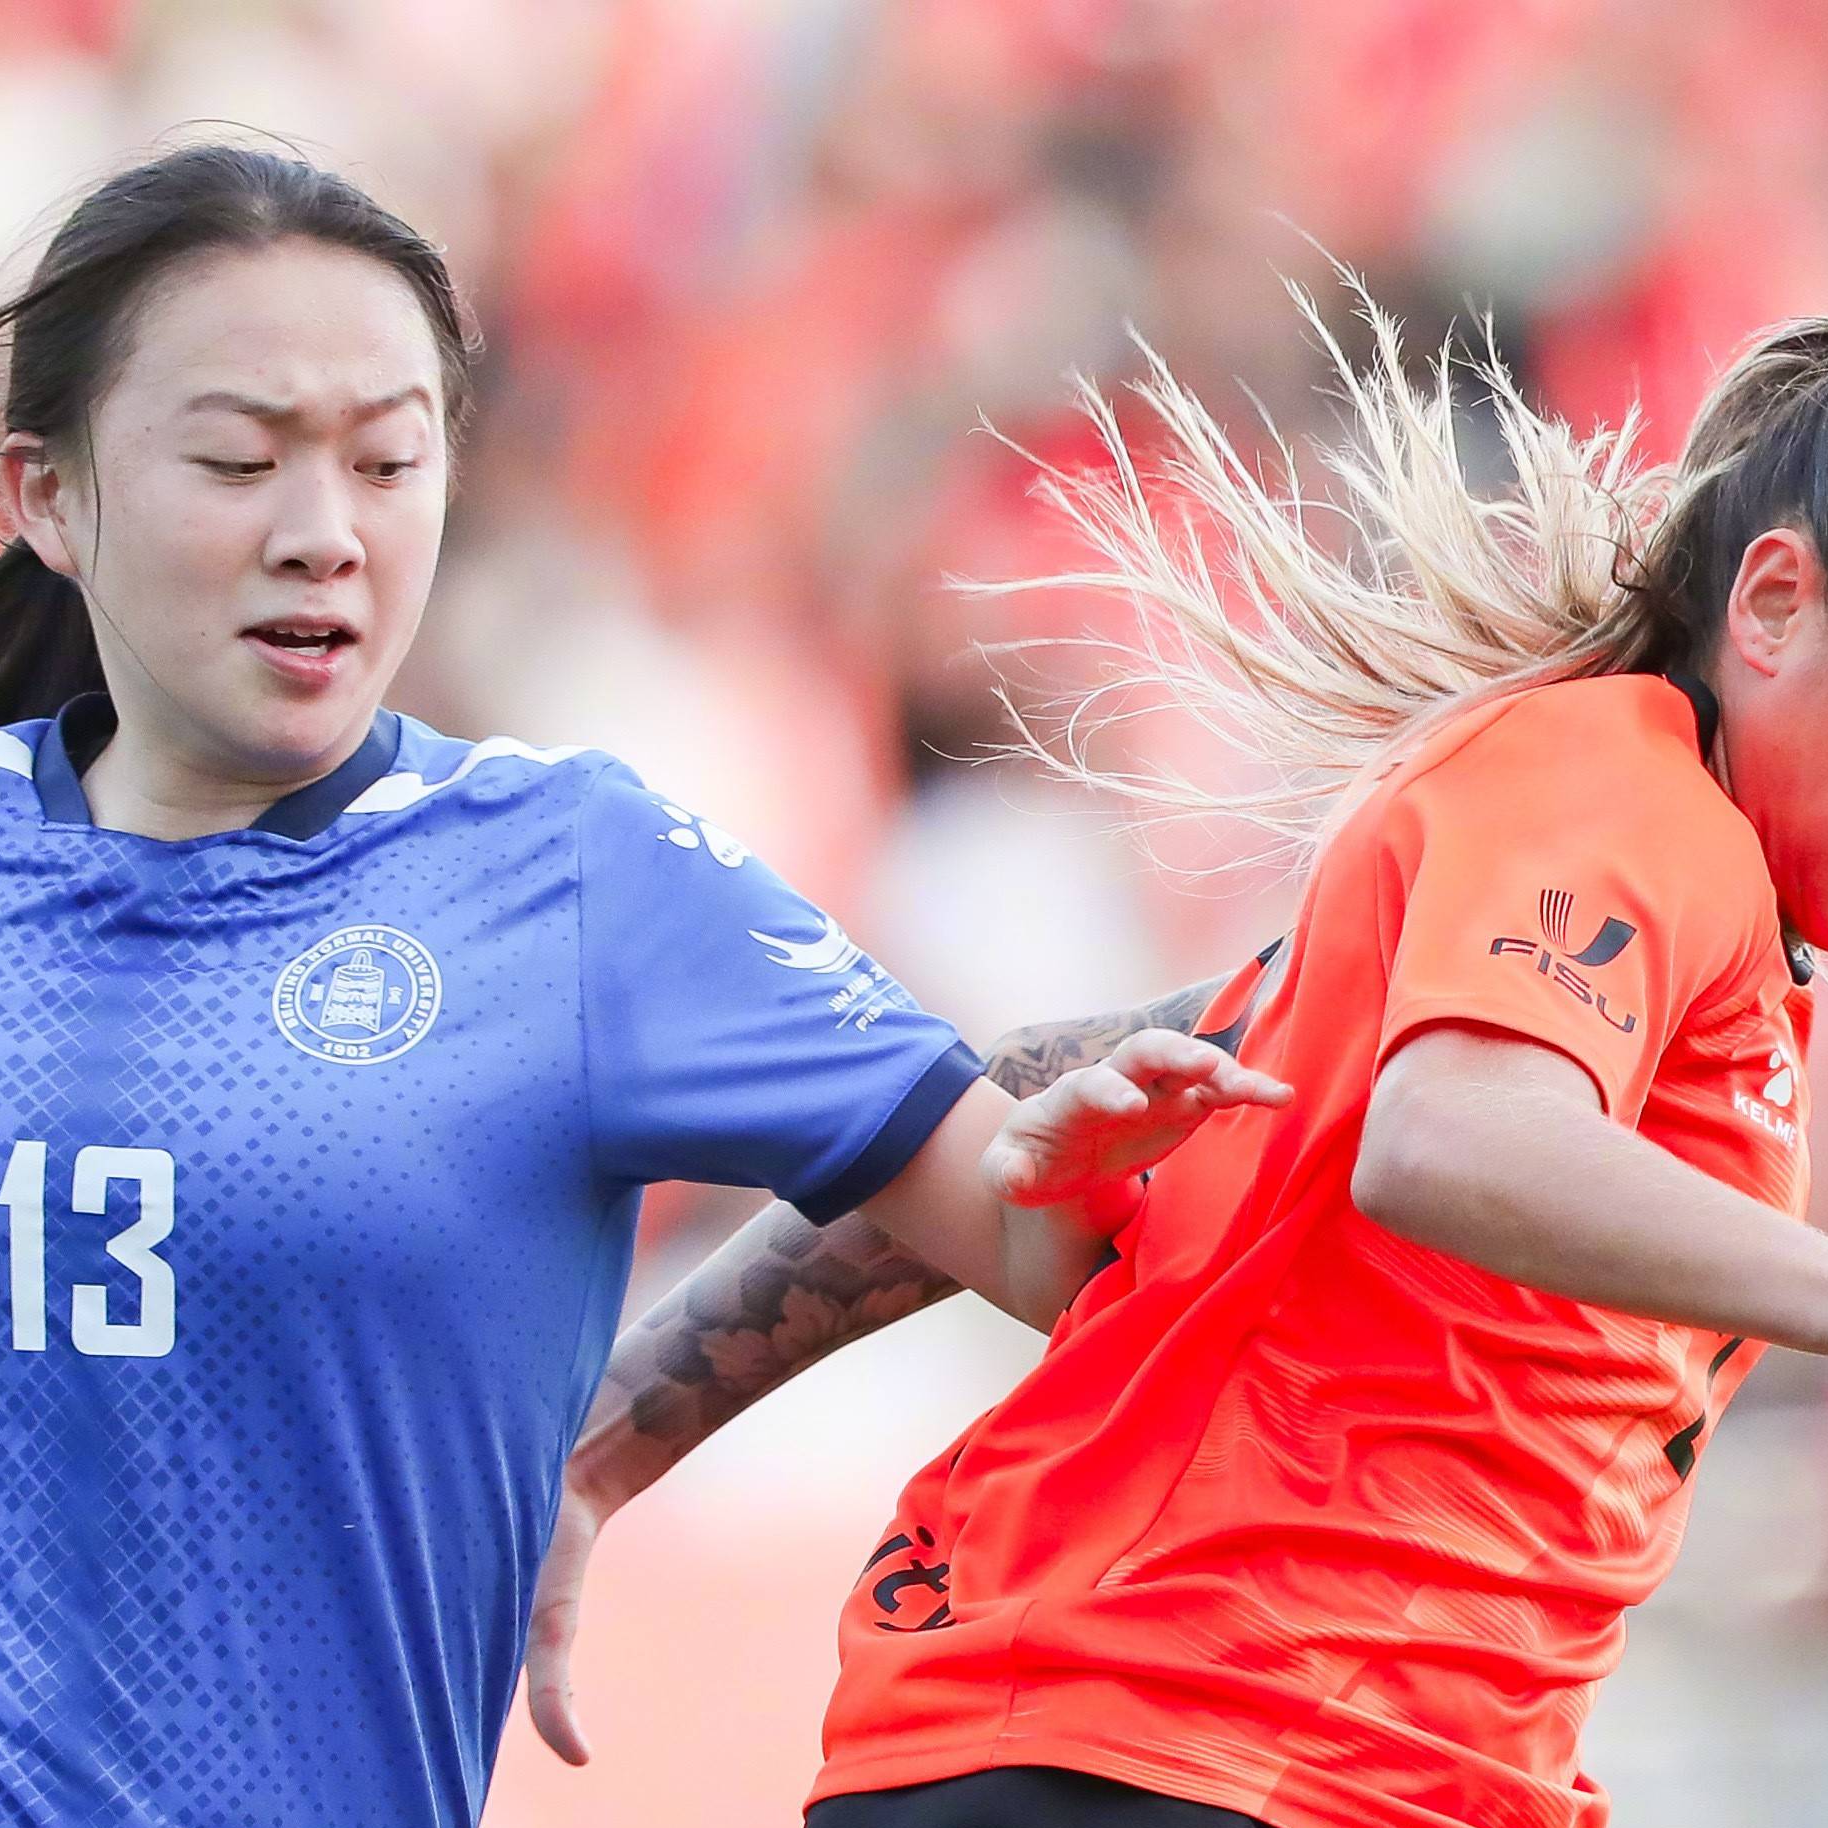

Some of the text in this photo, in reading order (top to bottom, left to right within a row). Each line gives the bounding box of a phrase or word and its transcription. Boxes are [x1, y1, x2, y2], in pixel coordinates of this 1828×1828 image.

[279, 931, 435, 1041] BEIJING NORMAL UNIVERSITY
[1490, 937, 1637, 1033] FISU
[322, 1042, 372, 1058] 1902
[1734, 1091, 1797, 1149] KELME
